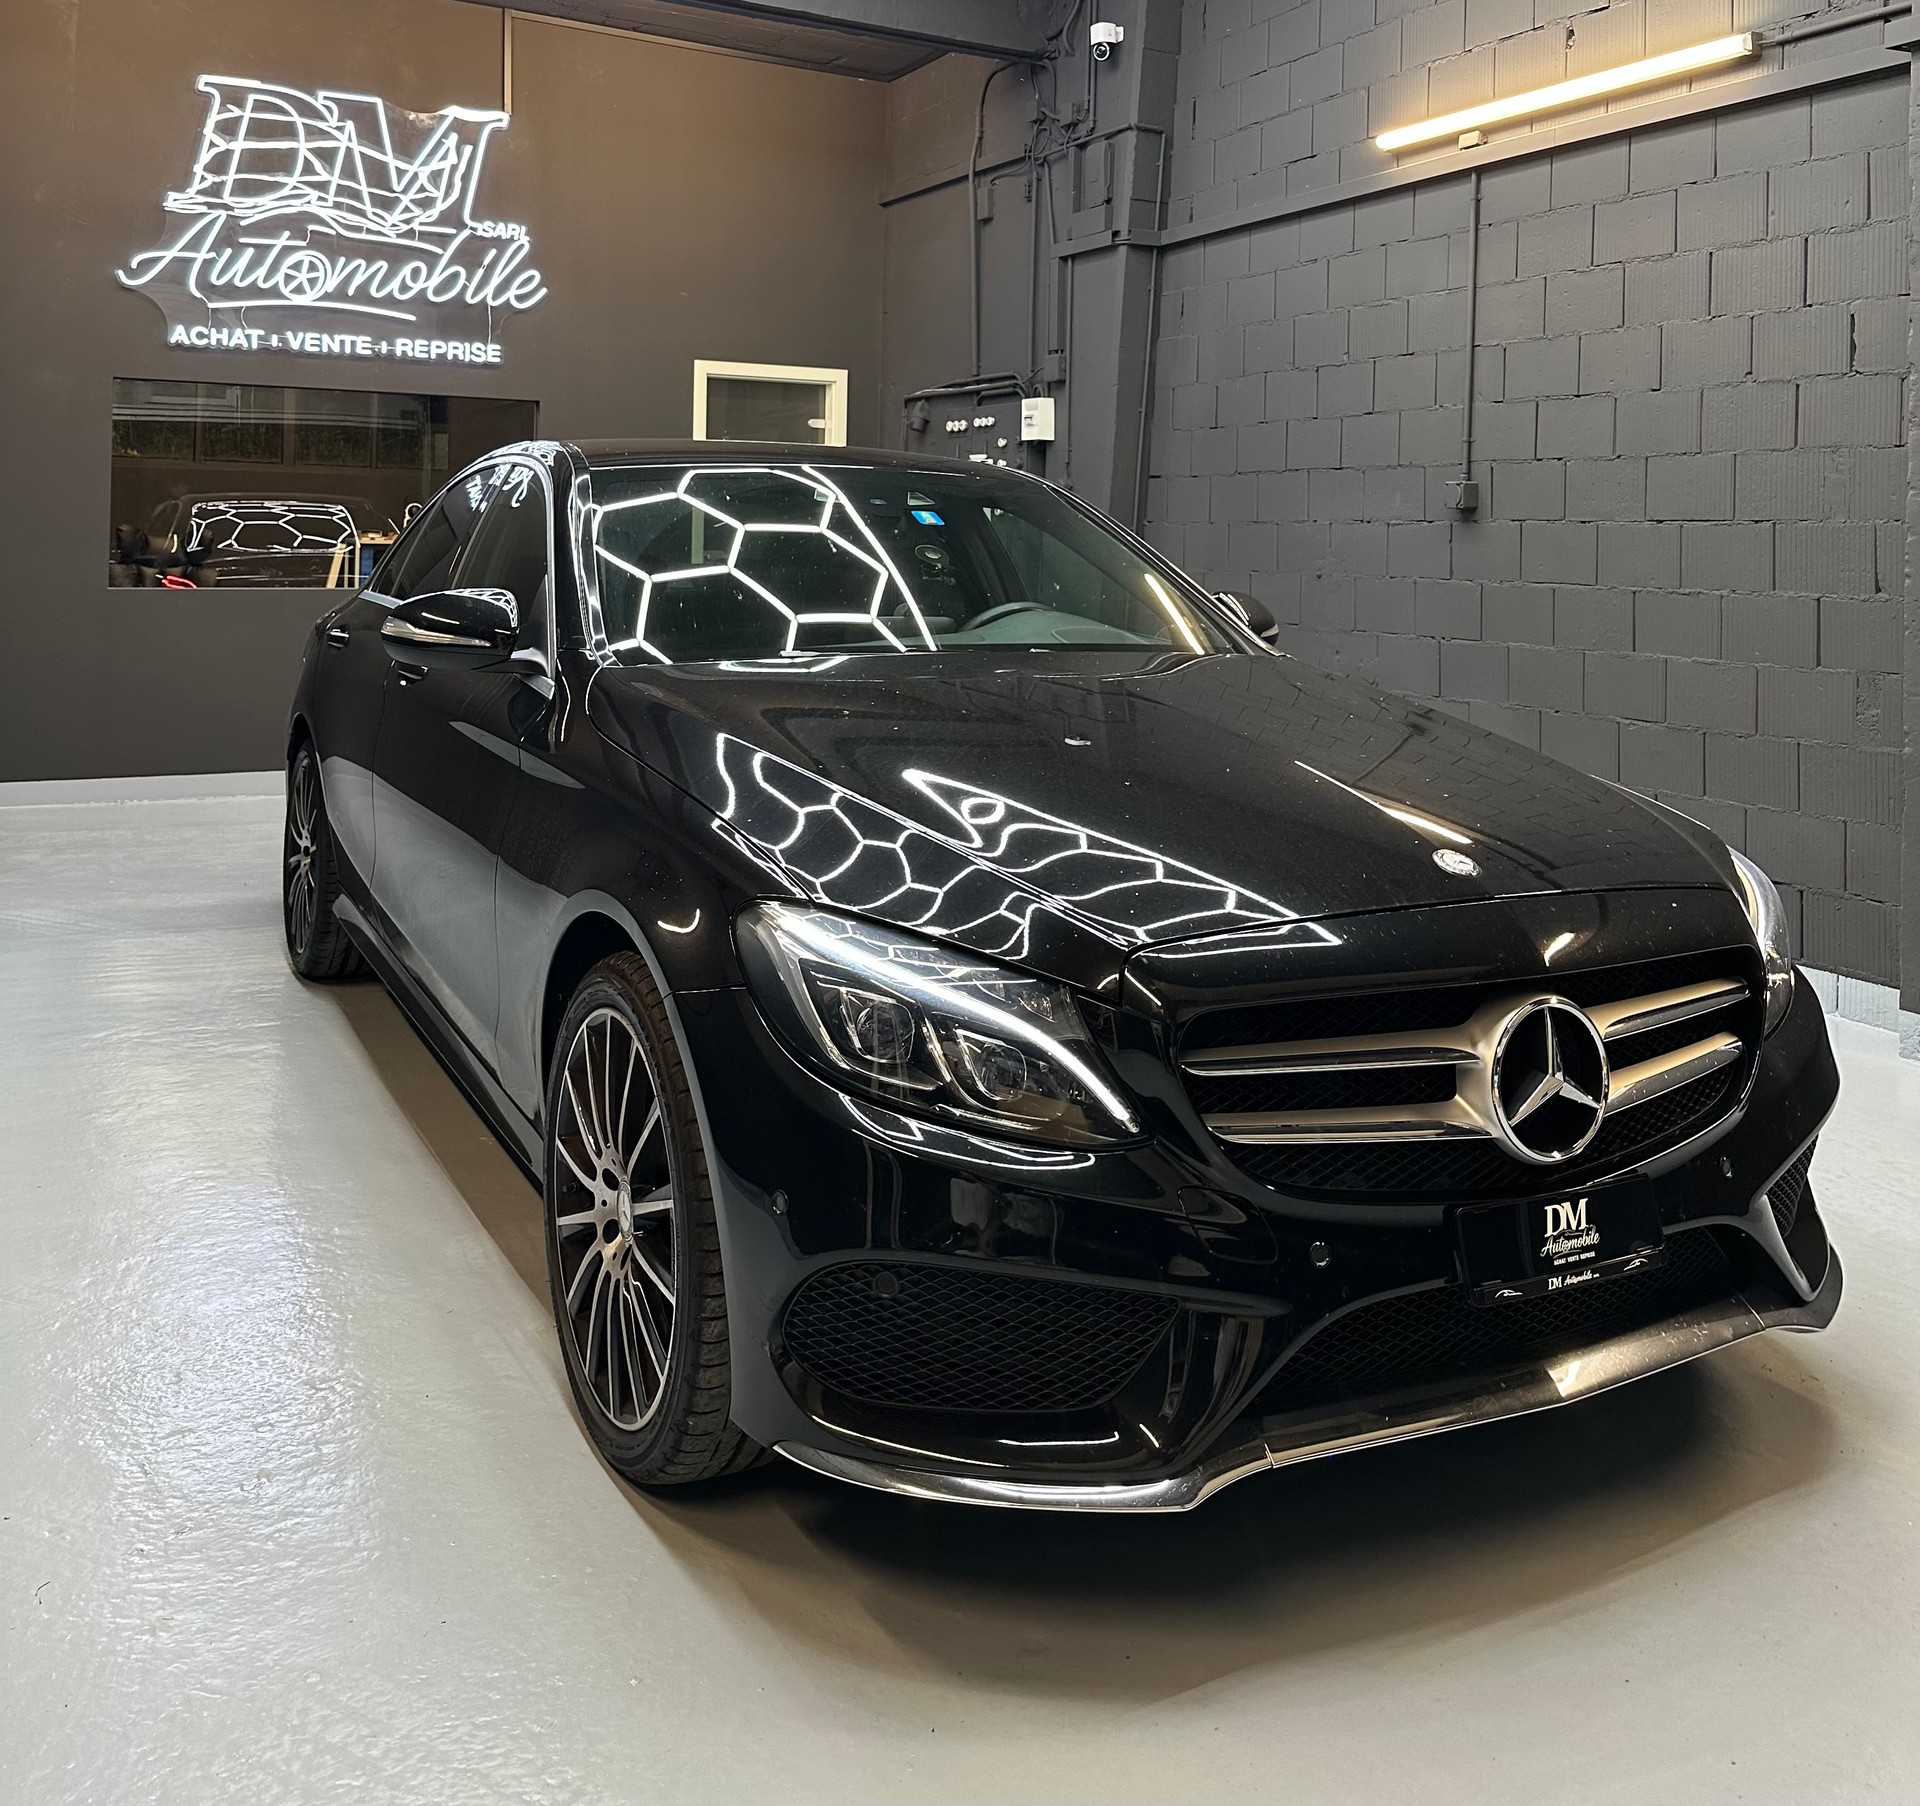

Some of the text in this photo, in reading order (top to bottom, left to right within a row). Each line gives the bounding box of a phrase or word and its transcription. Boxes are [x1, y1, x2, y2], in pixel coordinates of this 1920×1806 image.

[164, 74, 509, 230] DM
[481, 221, 530, 241] SARL
[115, 210, 548, 309] Automobile
[170, 324, 502, 363] ACHAT VENTE REPRISE
[1544, 1198, 1588, 1237] DM
[1540, 1224, 1600, 1257] Automobile
[1548, 1276, 1562, 1290] DM
